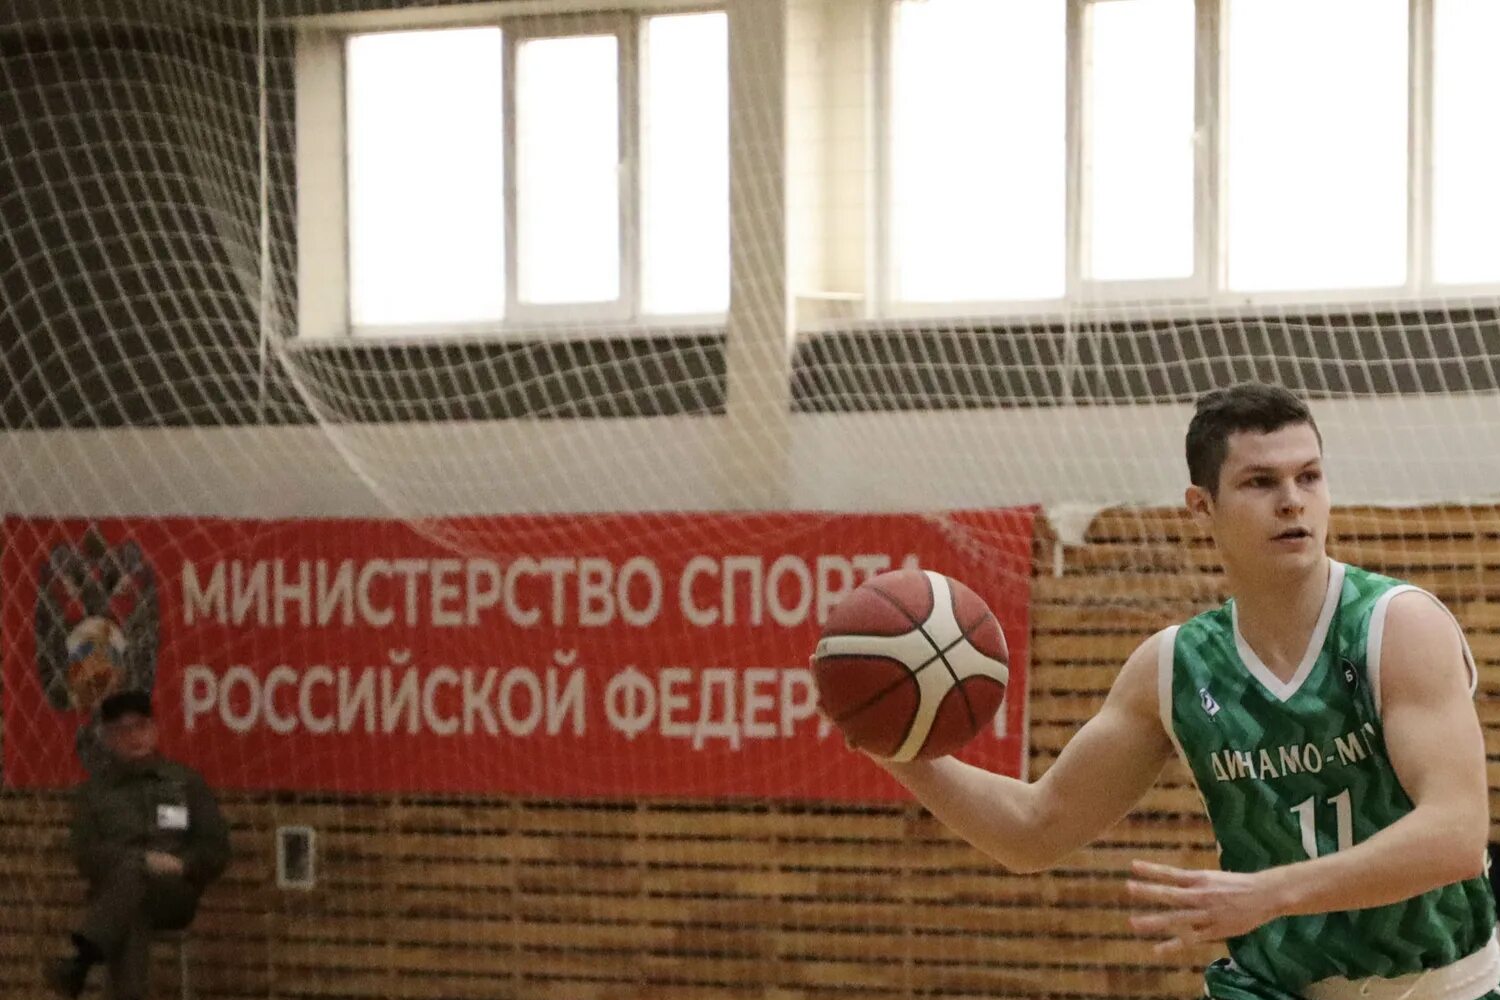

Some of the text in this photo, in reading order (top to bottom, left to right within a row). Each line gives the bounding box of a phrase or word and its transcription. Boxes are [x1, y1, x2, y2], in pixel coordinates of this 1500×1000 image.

[182, 553, 920, 627] МИНИСТЕРСТВО СПОРТ
[182, 648, 588, 738] РОССИЙСКОЙ
[1290, 787, 1354, 859] 11
